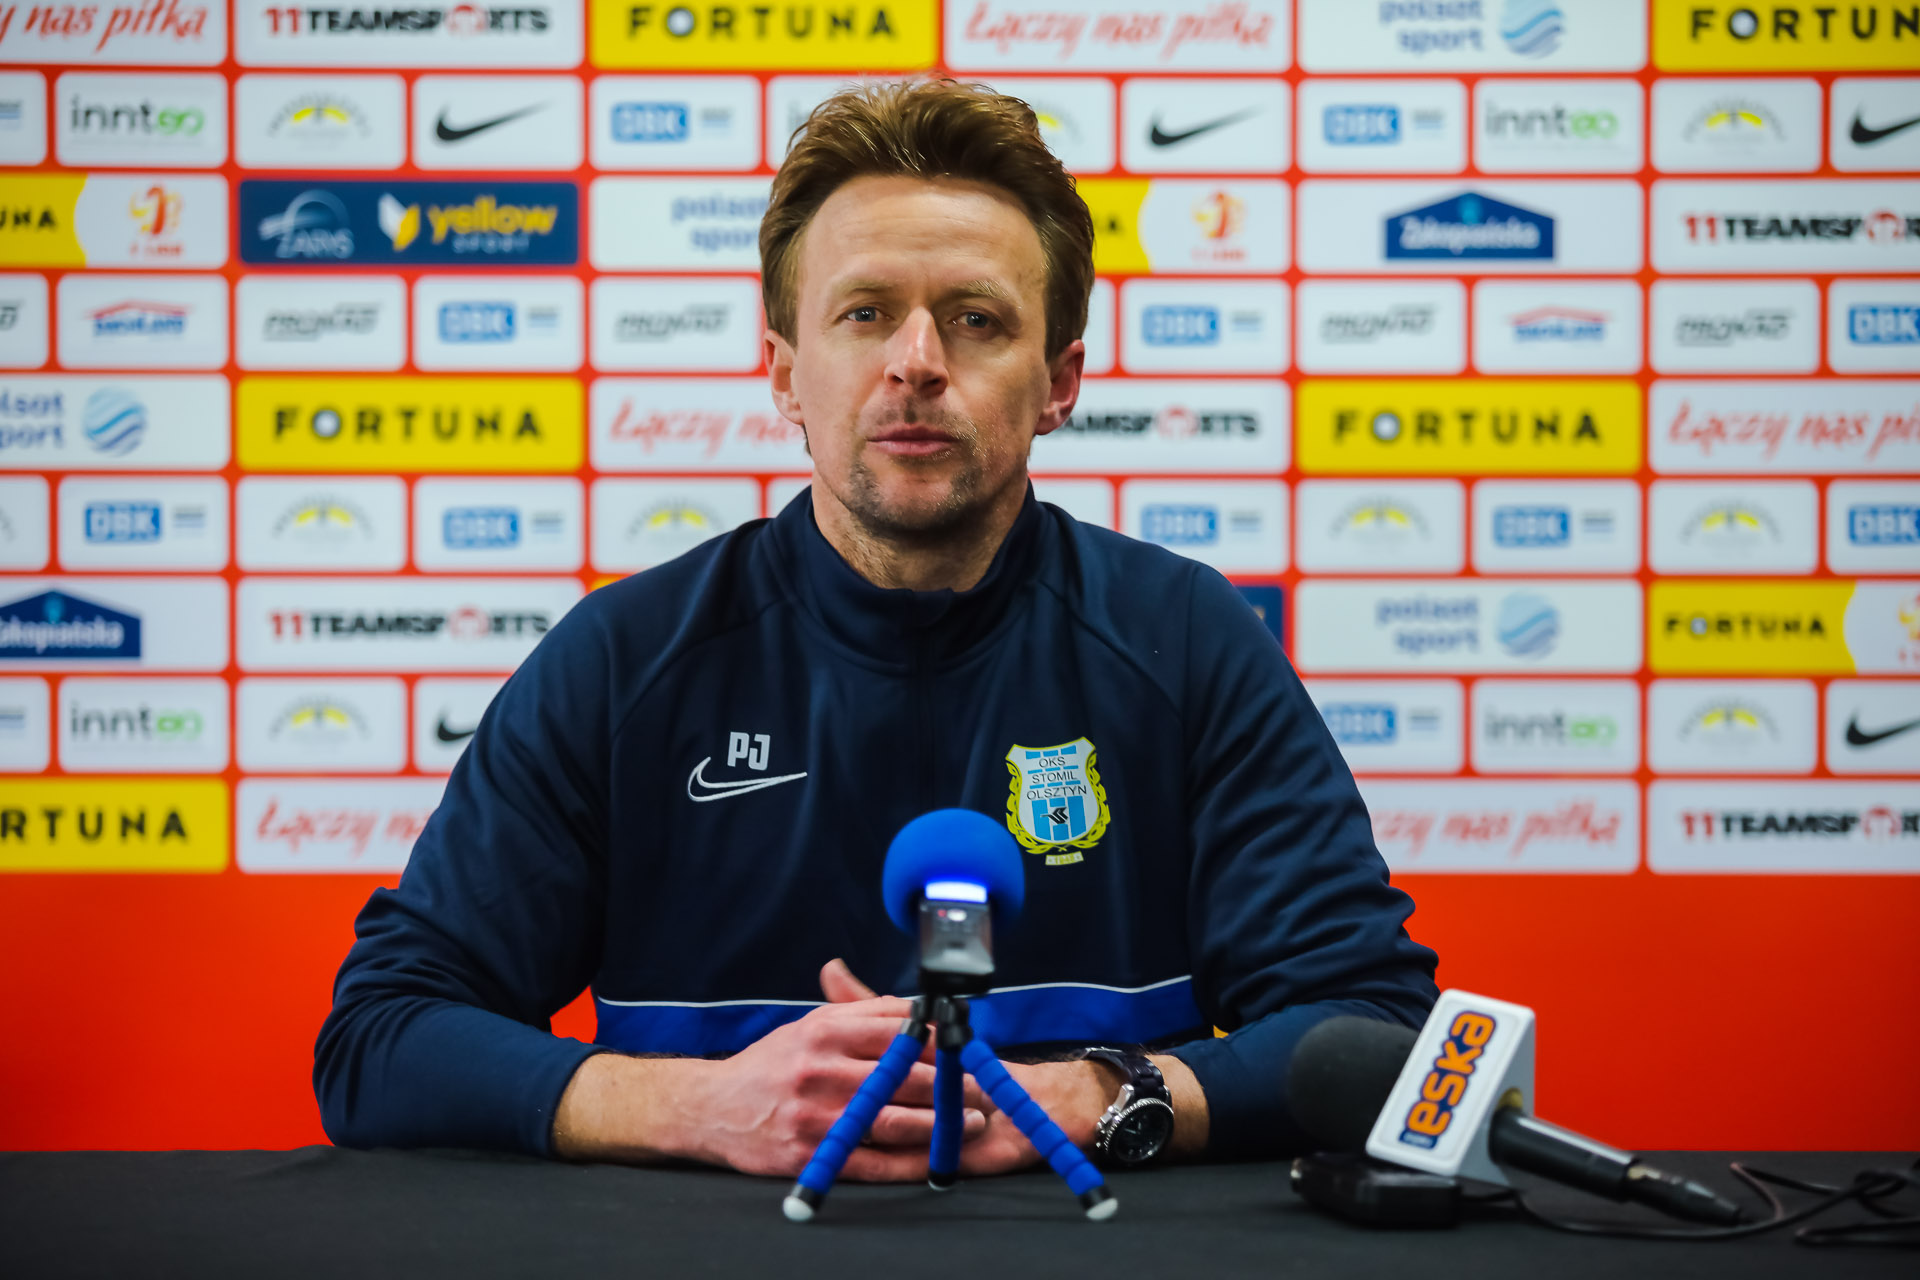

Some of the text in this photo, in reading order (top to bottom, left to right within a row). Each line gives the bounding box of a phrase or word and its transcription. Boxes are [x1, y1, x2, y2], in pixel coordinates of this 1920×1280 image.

[24, 5, 96, 37] nas
[629, 5, 897, 38] FORTUNA
[1691, 7, 1920, 40] FORTUN
[1397, 28, 1482, 56] sport
[428, 194, 558, 243] yellow
[275, 407, 543, 442] FORTUNA
[1333, 408, 1602, 445] FORTUNA
[1798, 410, 1869, 449] nas
[1664, 611, 1827, 641] FORTUNA
[727, 731, 770, 770] PJ
[1038, 756, 1065, 769] OKS
[1026, 784, 1087, 800] OLSZTYN
[1031, 770, 1077, 784] STOMIL
[1406, 1012, 1495, 1136] eska
